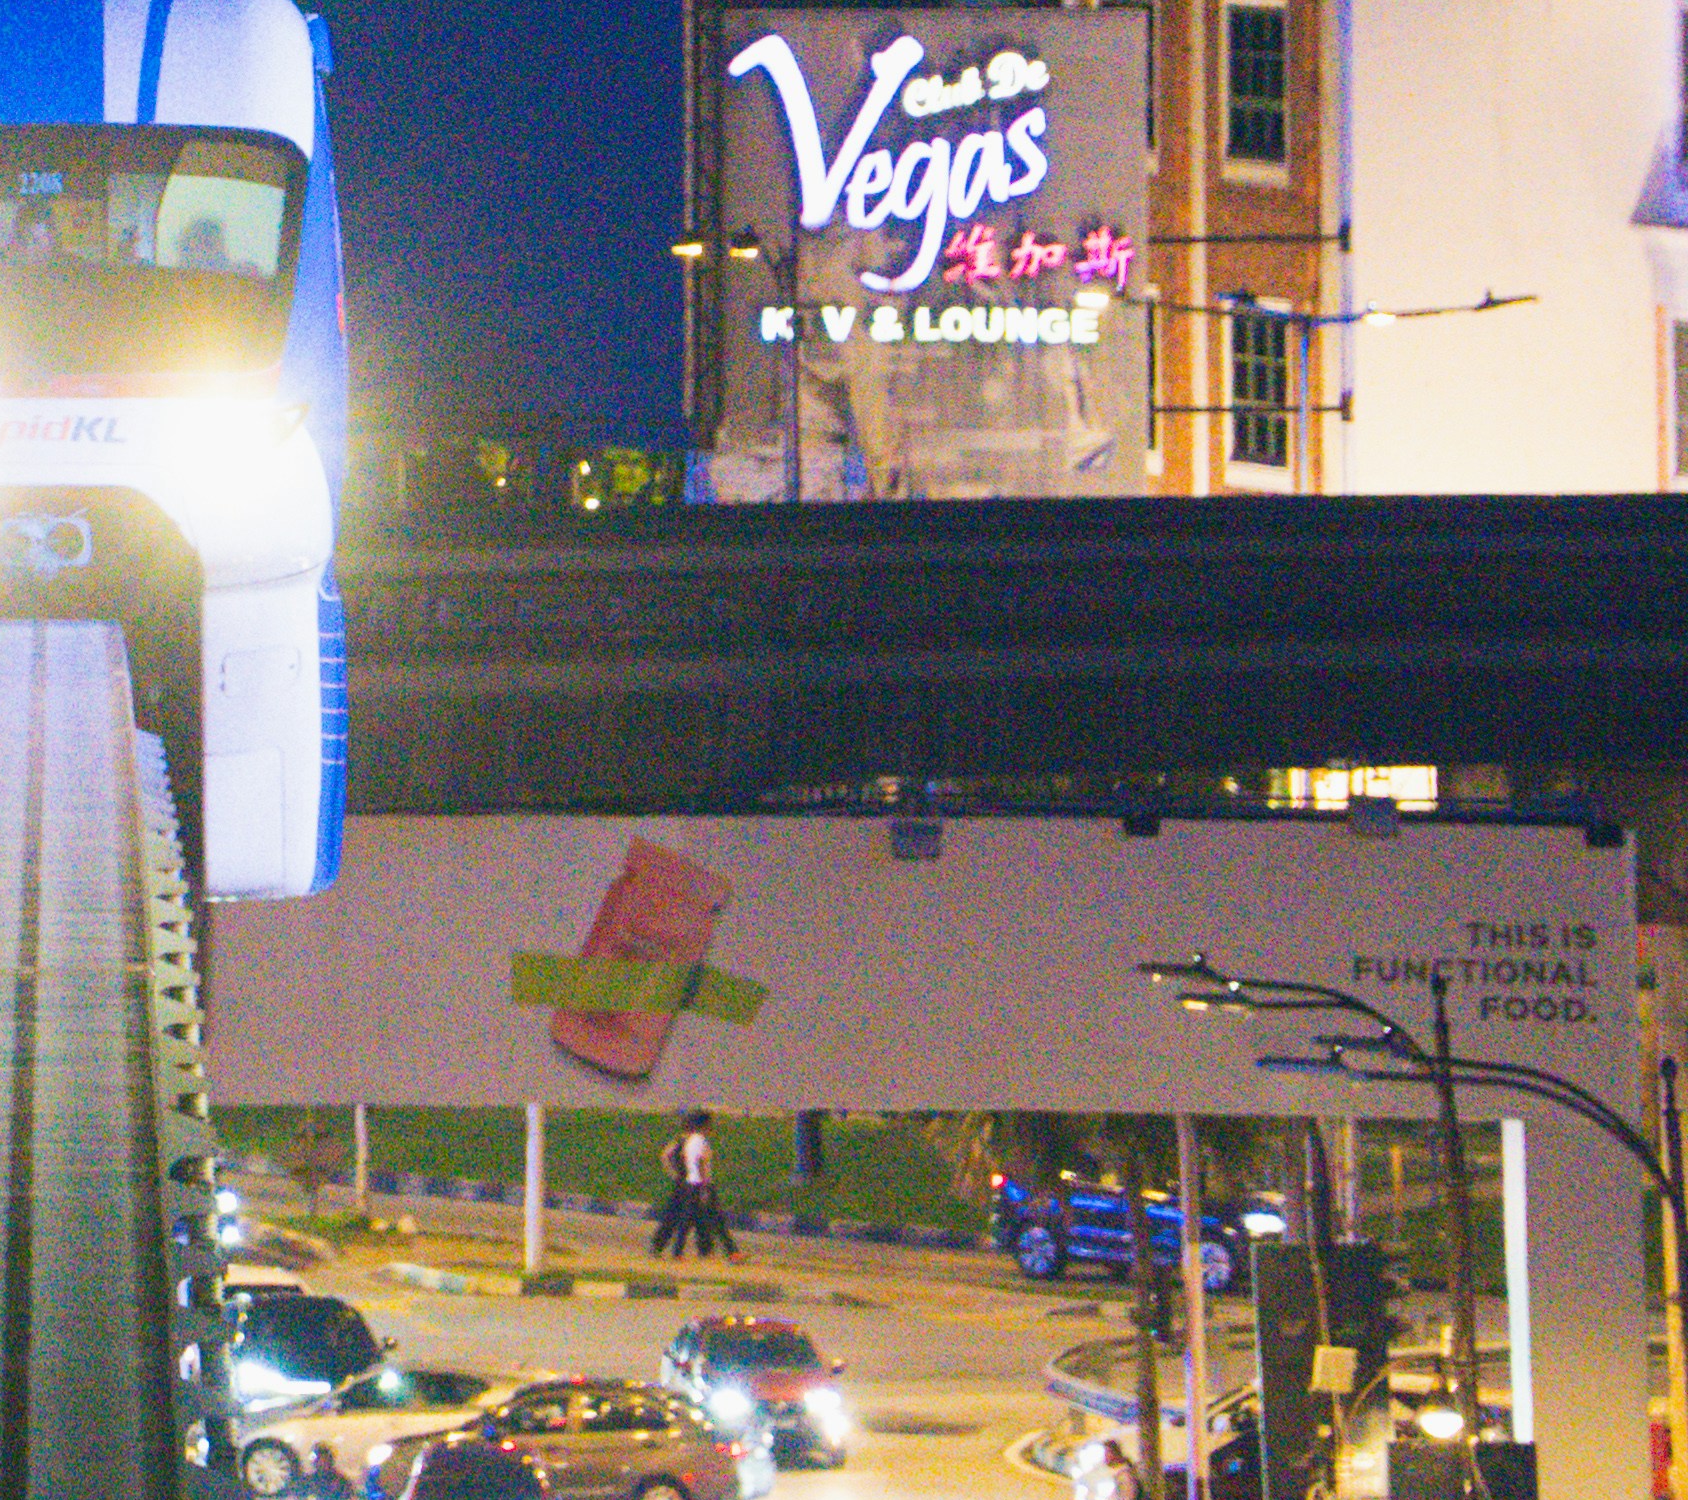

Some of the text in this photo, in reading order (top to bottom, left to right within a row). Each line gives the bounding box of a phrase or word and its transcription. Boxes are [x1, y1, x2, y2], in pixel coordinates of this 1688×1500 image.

[902, 51, 1050, 118] Club De
[728, 34, 1049, 291] Vegas
[761, 305, 1101, 344] KV & LOUNGE
[1466, 922, 1597, 950] THIS IS
[1353, 957, 1598, 988] FUNCTIONAL
[1478, 995, 1599, 1023] FOOD.
